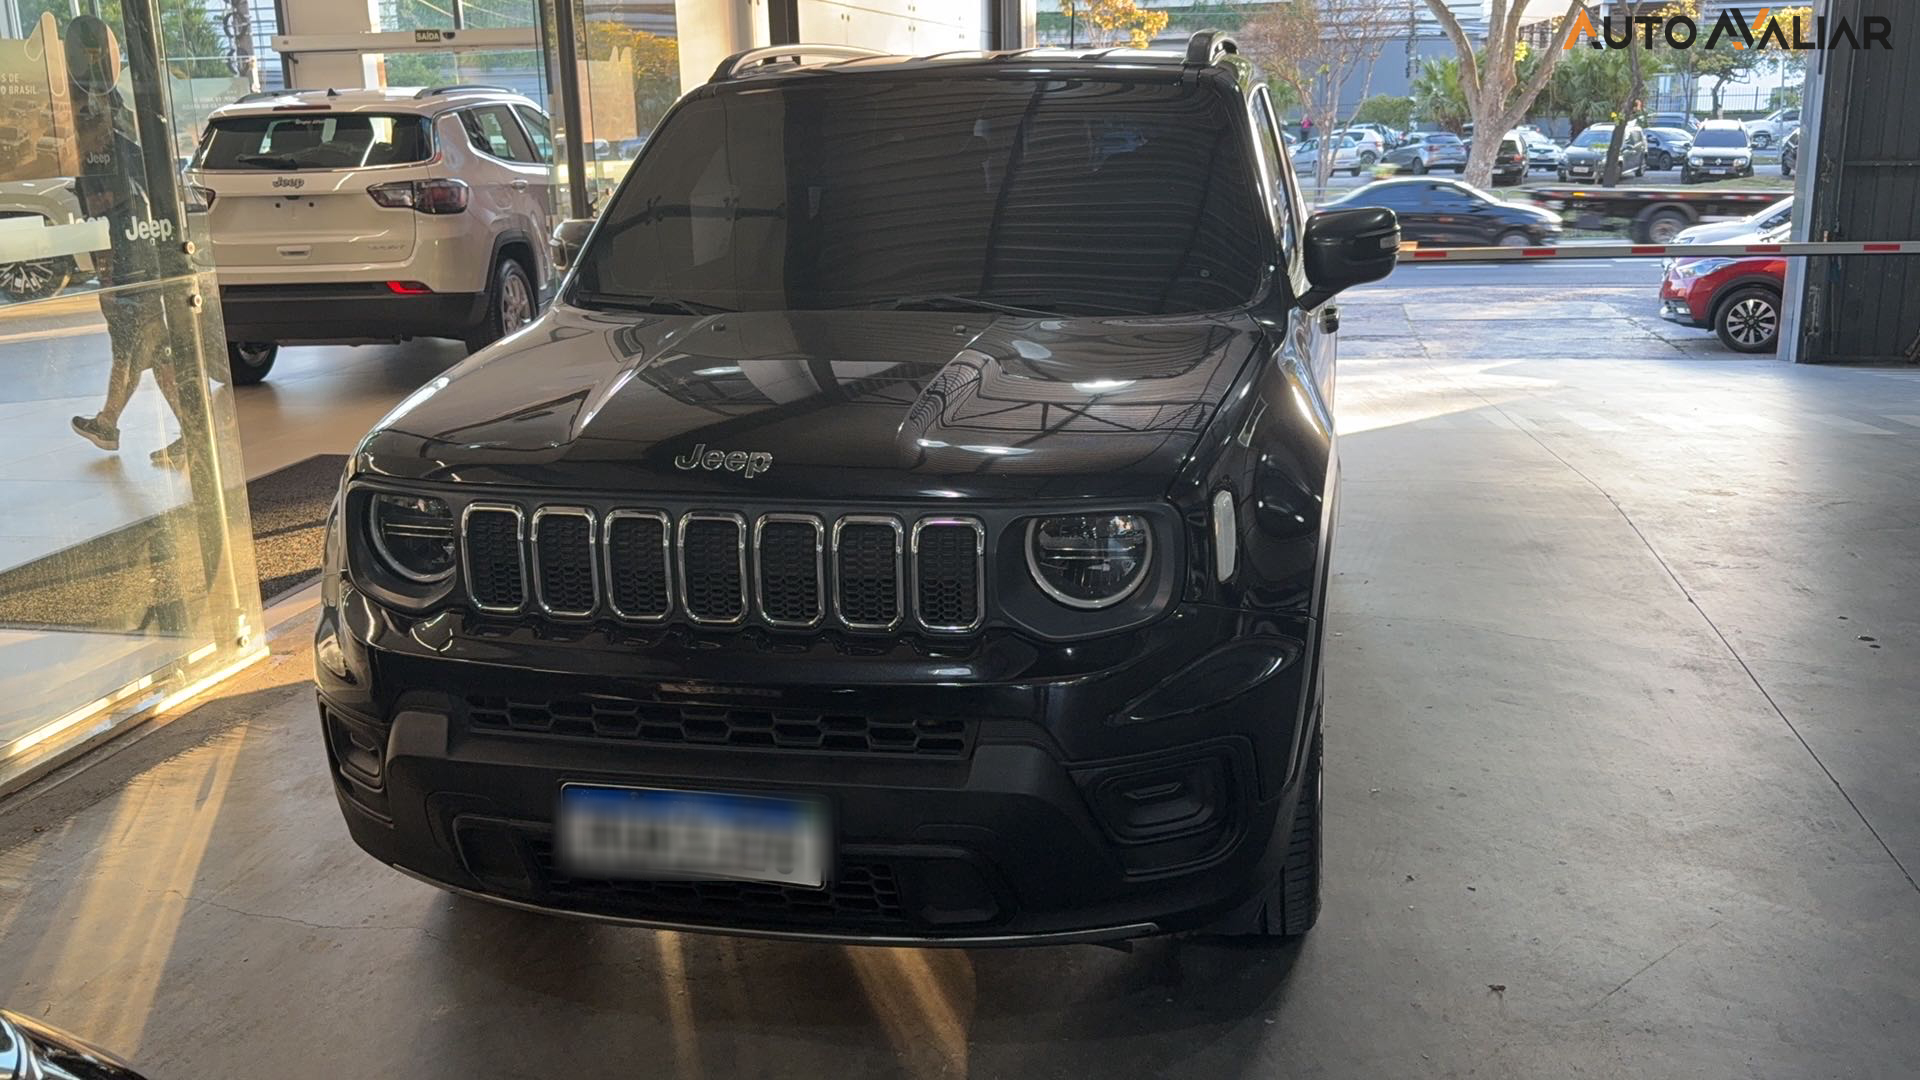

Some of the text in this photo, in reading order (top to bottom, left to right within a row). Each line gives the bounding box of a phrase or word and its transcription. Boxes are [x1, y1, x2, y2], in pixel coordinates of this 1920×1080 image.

[416, 31, 439, 41] SAÍDA
[8, 73, 19, 82] DE
[87, 151, 111, 166] Jeep
[272, 176, 304, 189] Jeep
[125, 216, 172, 241] Jeep
[674, 443, 773, 478] Jeep
